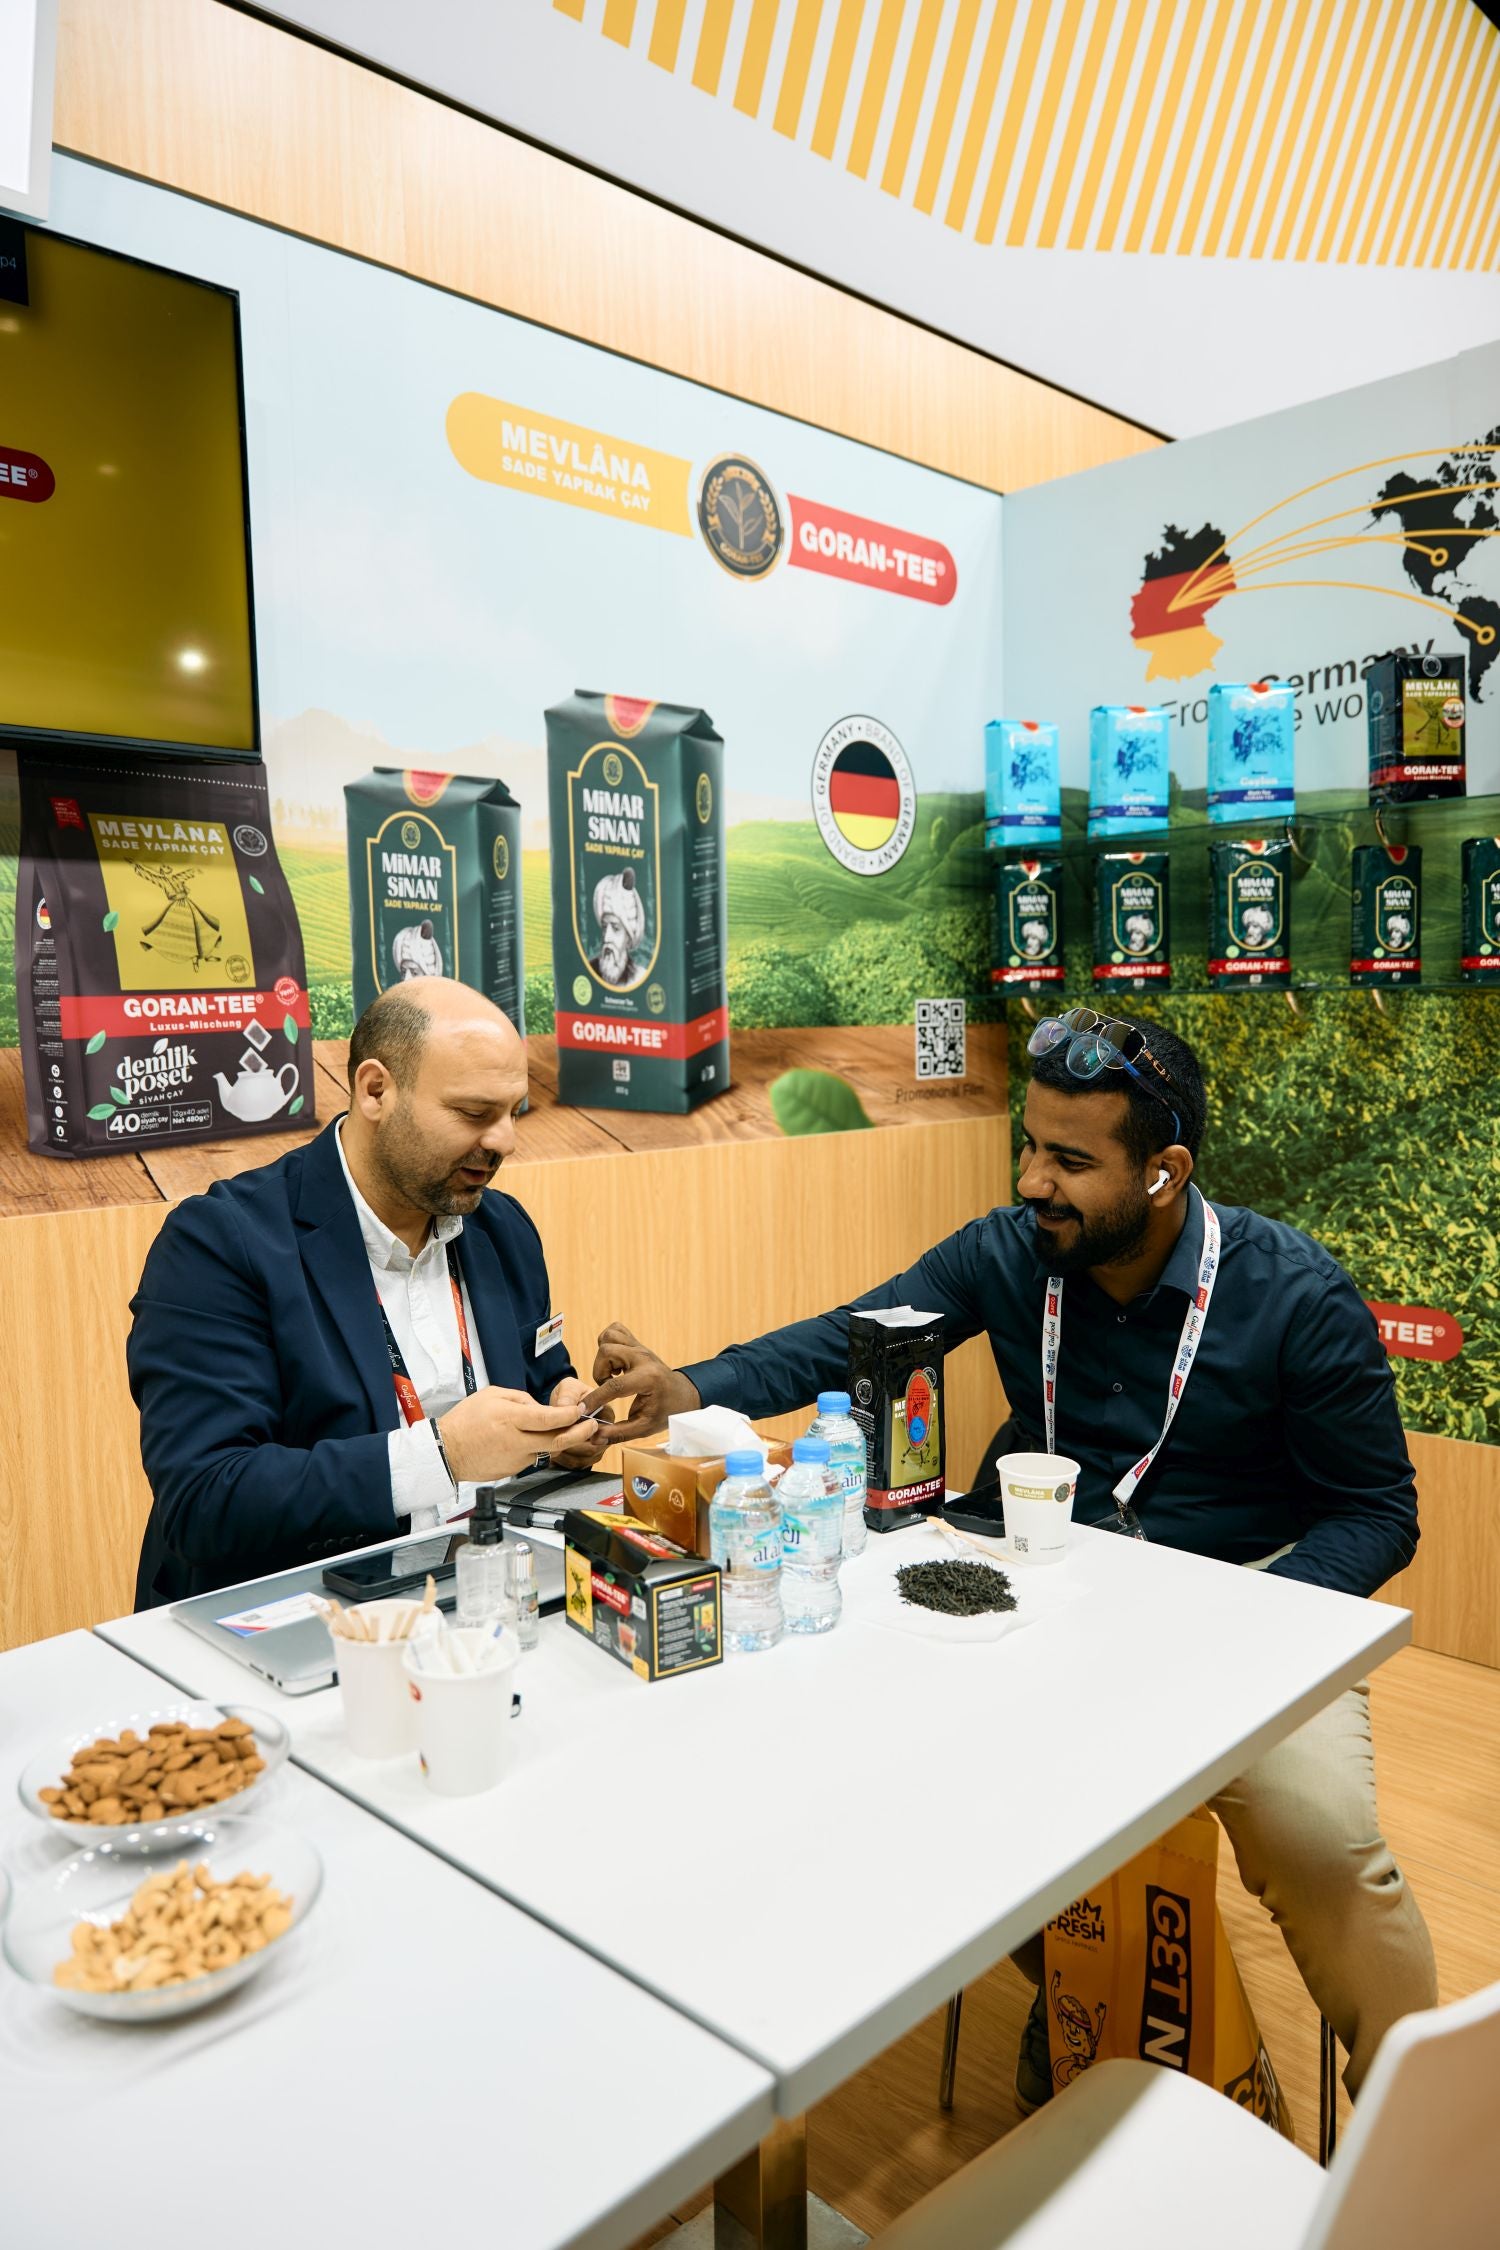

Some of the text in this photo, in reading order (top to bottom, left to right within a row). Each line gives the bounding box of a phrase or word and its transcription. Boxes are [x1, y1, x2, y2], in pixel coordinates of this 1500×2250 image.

[501, 419, 651, 491] MEVLÂNA
[501, 455, 651, 511] SADE YAPRAK ÇAY
[1160, 699, 1208, 727] Fro
[816, 722, 854, 796] GERMANY
[102, 838, 225, 857] SADE YAPRAK ÇAY
[149, 1019, 242, 1032] Luxus-Mischung
[116, 1044, 198, 1080] demlik
[124, 1065, 193, 1101] poşet
[166, 1089, 184, 1101] ÇAY
[109, 1113, 141, 1134] 40
[172, 1117, 185, 1125] Net
[1044, 1321, 1059, 1347] Gulfood
[1187, 1315, 1200, 1342] Gulfood
[400, 1384, 417, 1409] Gulfood
[841, 1473, 863, 1489] ain
[753, 1545, 768, 1563] al
